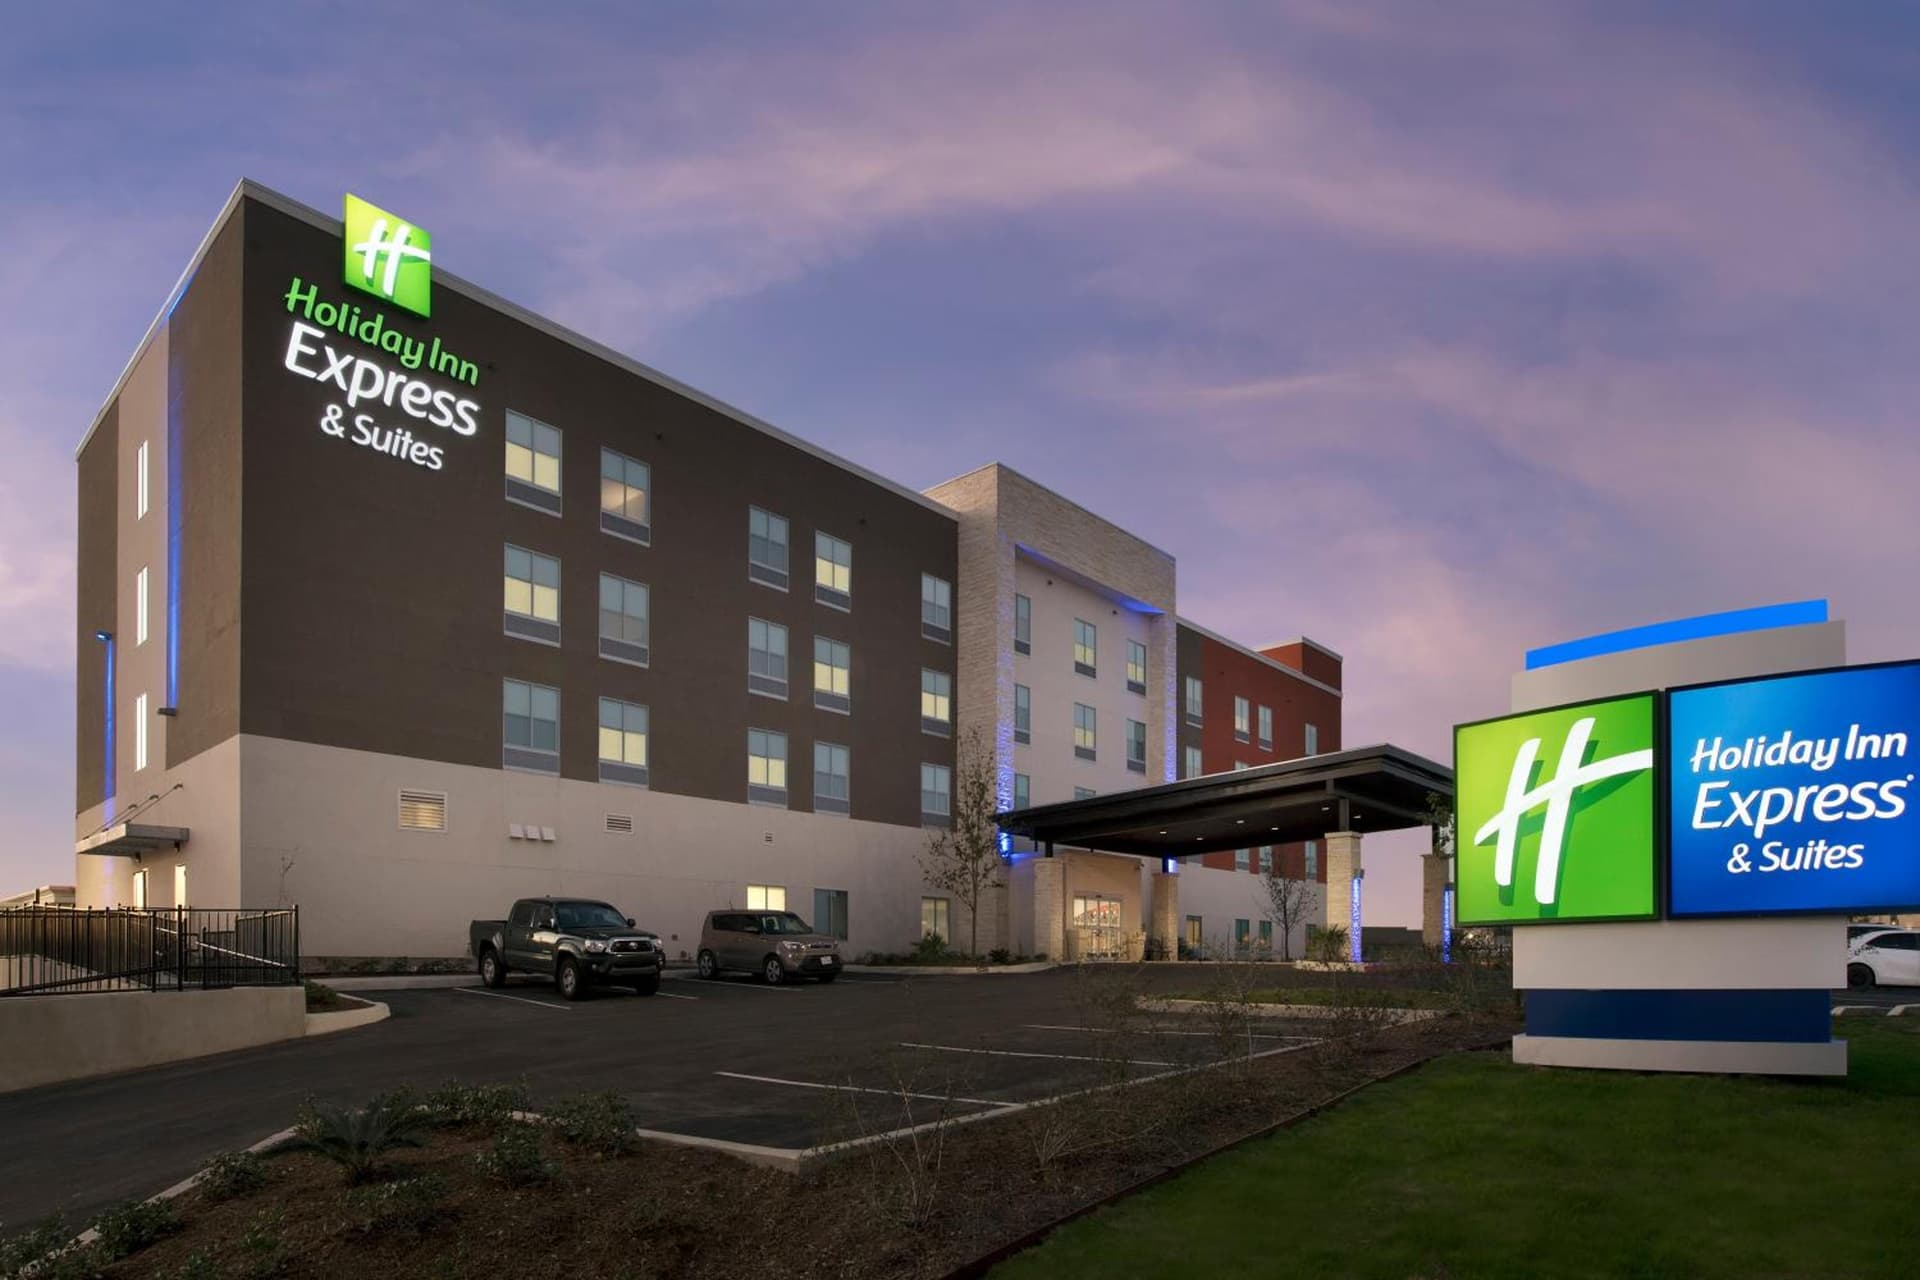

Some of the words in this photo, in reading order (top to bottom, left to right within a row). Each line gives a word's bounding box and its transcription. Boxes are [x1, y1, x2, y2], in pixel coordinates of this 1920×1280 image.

[354, 218, 430, 297] H
[284, 277, 424, 370] Holiday
[430, 337, 479, 385] Inn
[285, 321, 480, 436] Express
[320, 404, 345, 438] &
[352, 414, 444, 470] Suites
[1690, 731, 1837, 773] Holiday
[1846, 724, 1908, 761] Inn
[1474, 718, 1653, 904] H
[1692, 779, 1907, 839] Express
[1727, 843, 1751, 874] &
[1759, 841, 1865, 873] Suites
